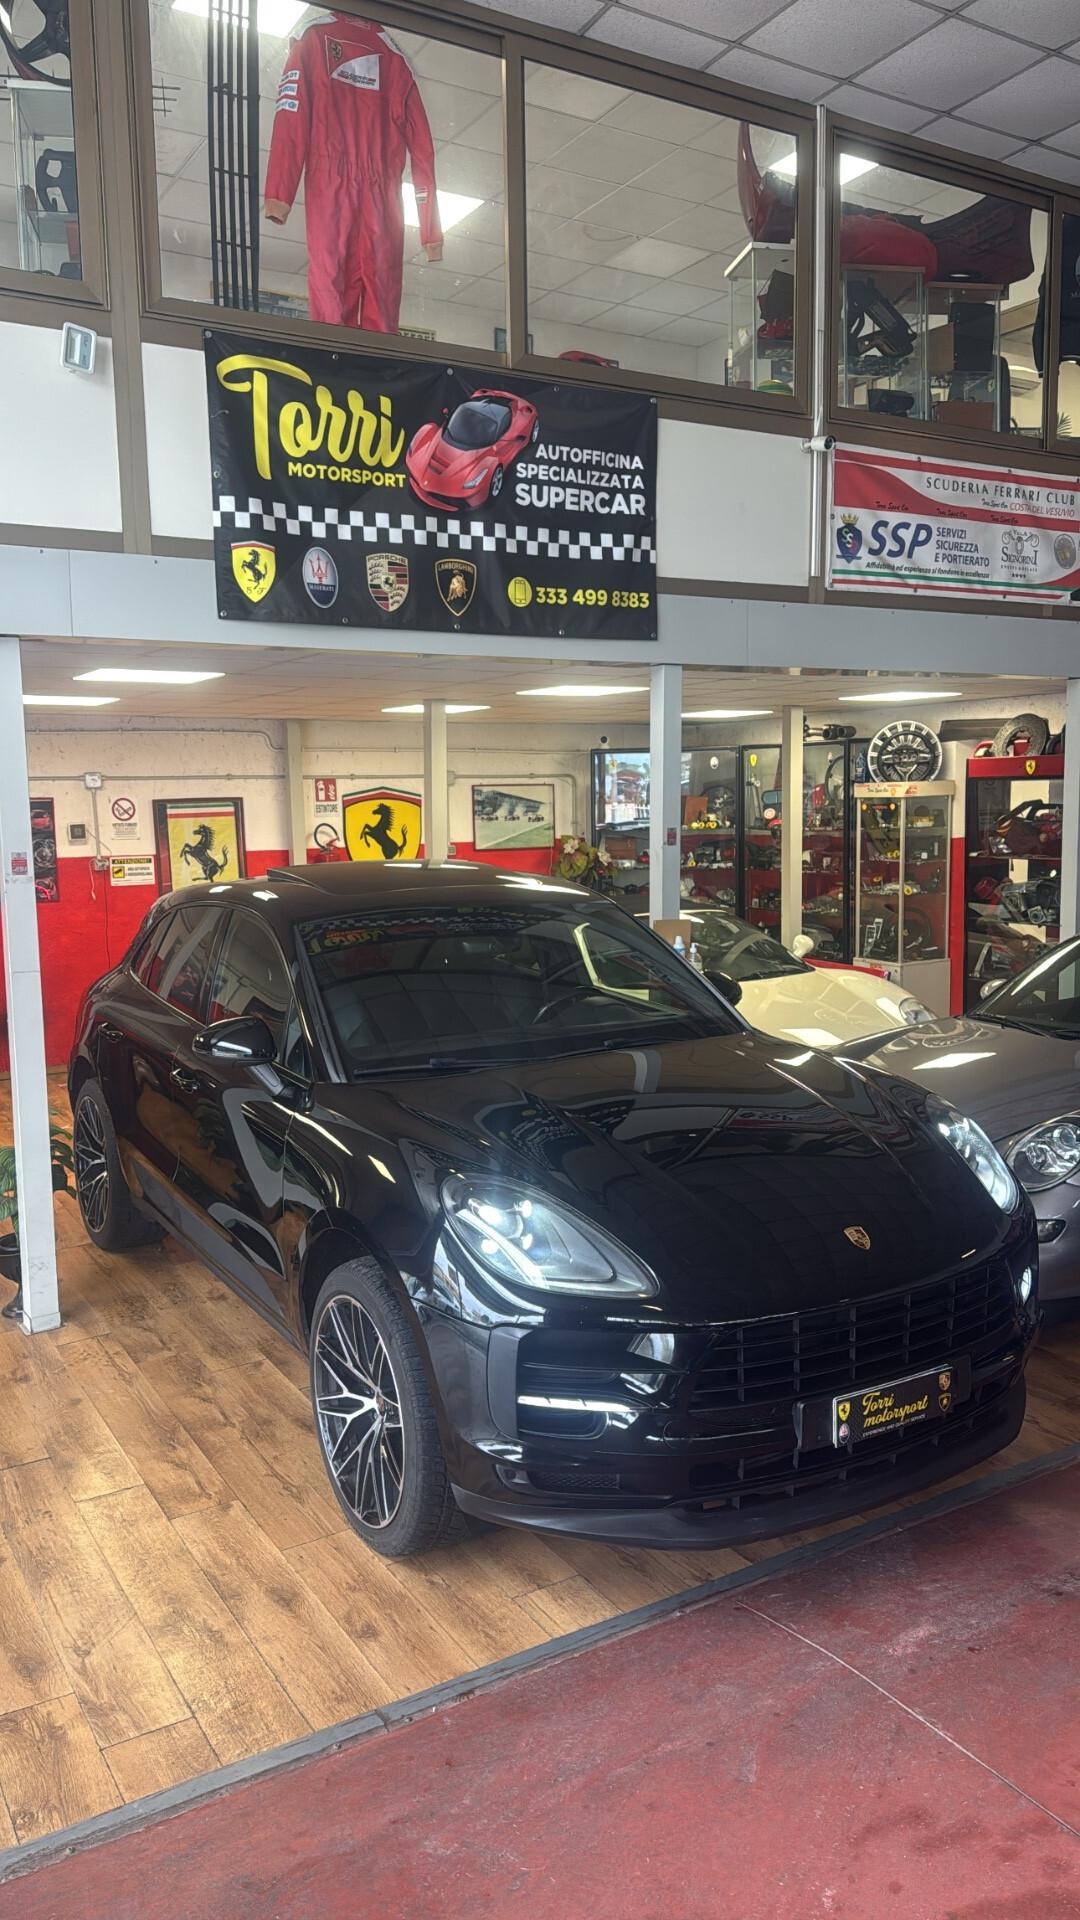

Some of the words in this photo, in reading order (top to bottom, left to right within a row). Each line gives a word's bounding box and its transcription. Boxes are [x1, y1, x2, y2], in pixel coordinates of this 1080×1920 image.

[216, 353, 406, 480] Torri
[535, 443, 645, 470] AUTOFFICINA
[288, 461, 407, 489] MOTORSPORT
[515, 462, 645, 490] SPECIALIZZATA
[514, 483, 646, 517] SUPERCAR
[926, 477, 989, 494] SCUDERIA
[994, 485, 1040, 501] FERRARI
[1046, 492, 1075, 506] CLUB
[1009, 502, 1033, 512] COSTA
[1046, 507, 1075, 517] VESUVIO
[867, 520, 933, 559] SSP
[936, 527, 966, 539] SERVIZI
[935, 540, 979, 553] SICUREZZA
[367, 554, 407, 566] PORSCHE
[438, 561, 474, 574] LAMBORGHINI
[934, 553, 940, 563] E
[941, 553, 990, 567] PORTIERATO
[536, 586, 568, 605] 333
[573, 588, 608, 606] 499
[612, 590, 649, 609] 8383
[862, 1392, 895, 1415] Torri
[863, 1395, 929, 1428] motorsport
